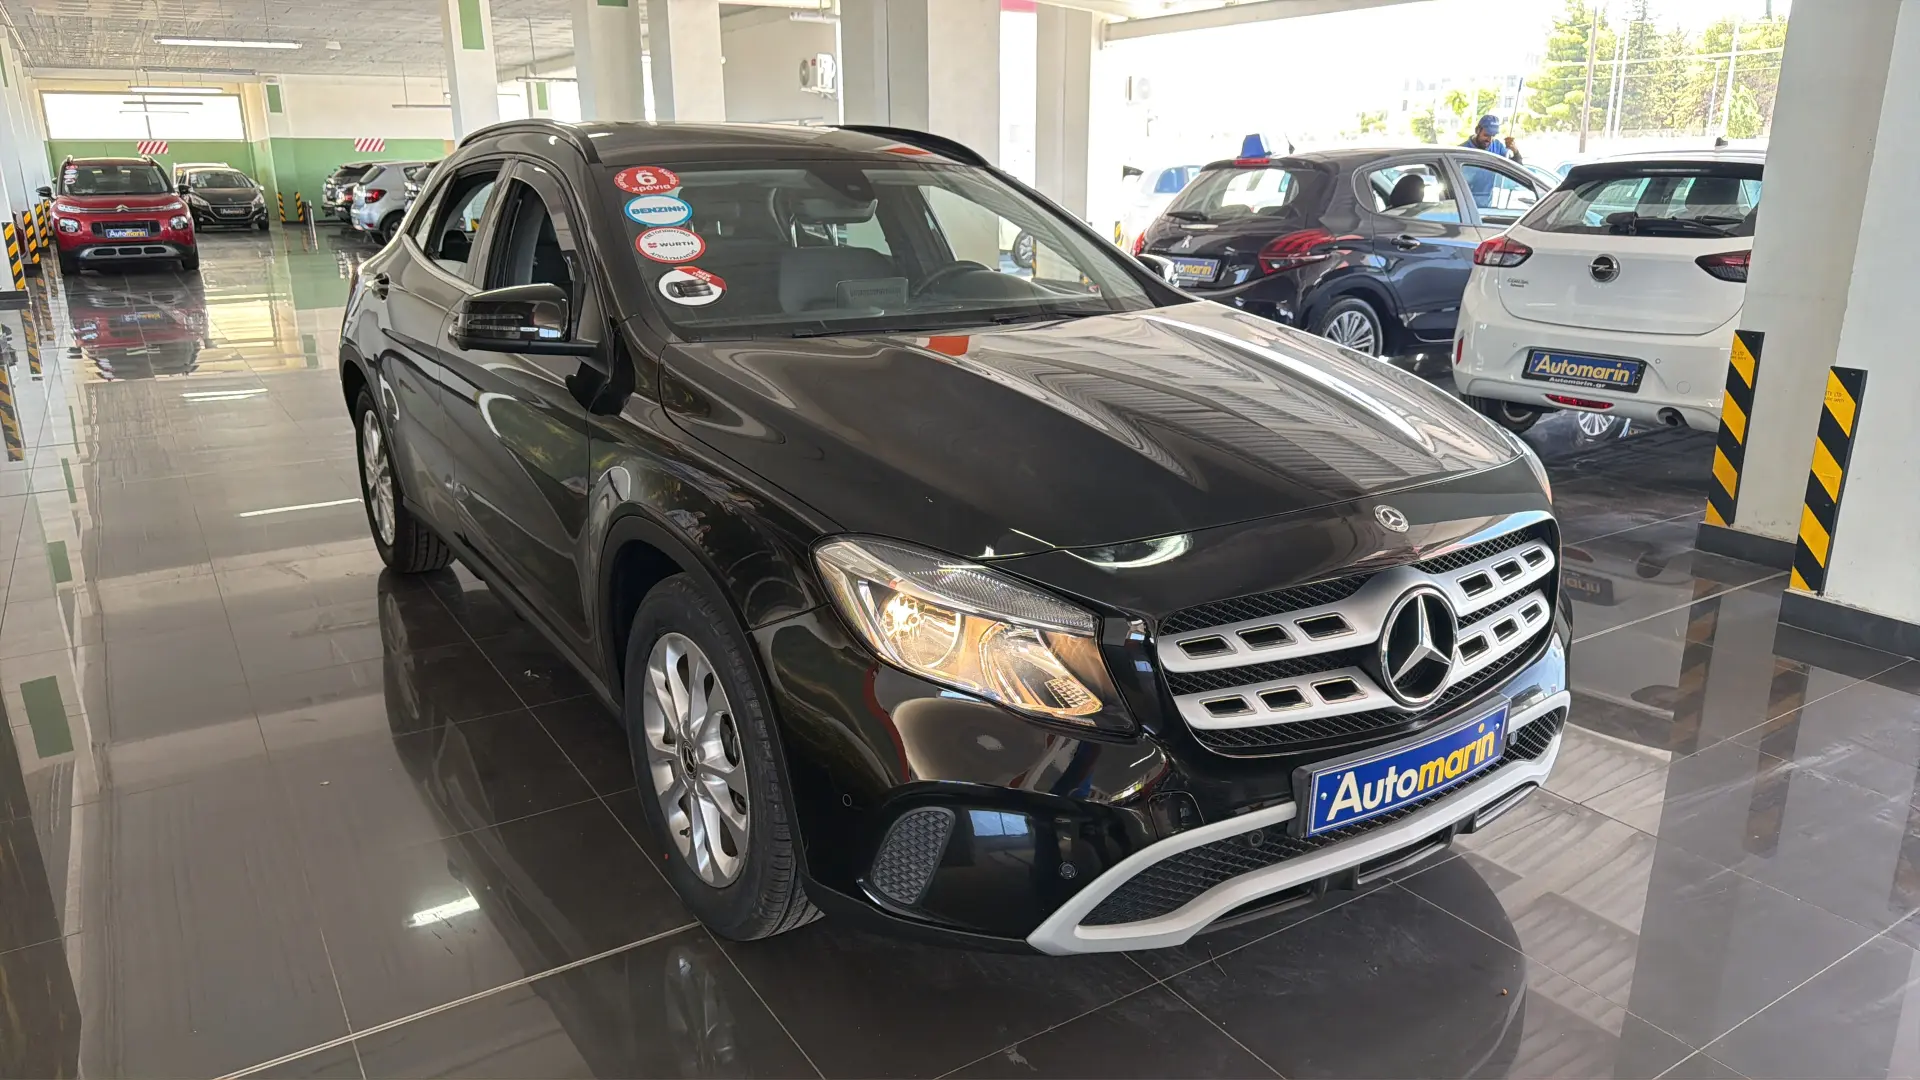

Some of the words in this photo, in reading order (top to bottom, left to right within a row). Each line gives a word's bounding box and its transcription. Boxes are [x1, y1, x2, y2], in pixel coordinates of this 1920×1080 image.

[635, 171, 658, 186] 6
[631, 184, 672, 193] χρόνια
[109, 229, 146, 238] Automarin
[1174, 261, 1212, 275] tomarin
[1534, 354, 1630, 383] Automarin
[1548, 376, 1607, 389] Automarin.gr
[1326, 722, 1495, 822] Automarin
